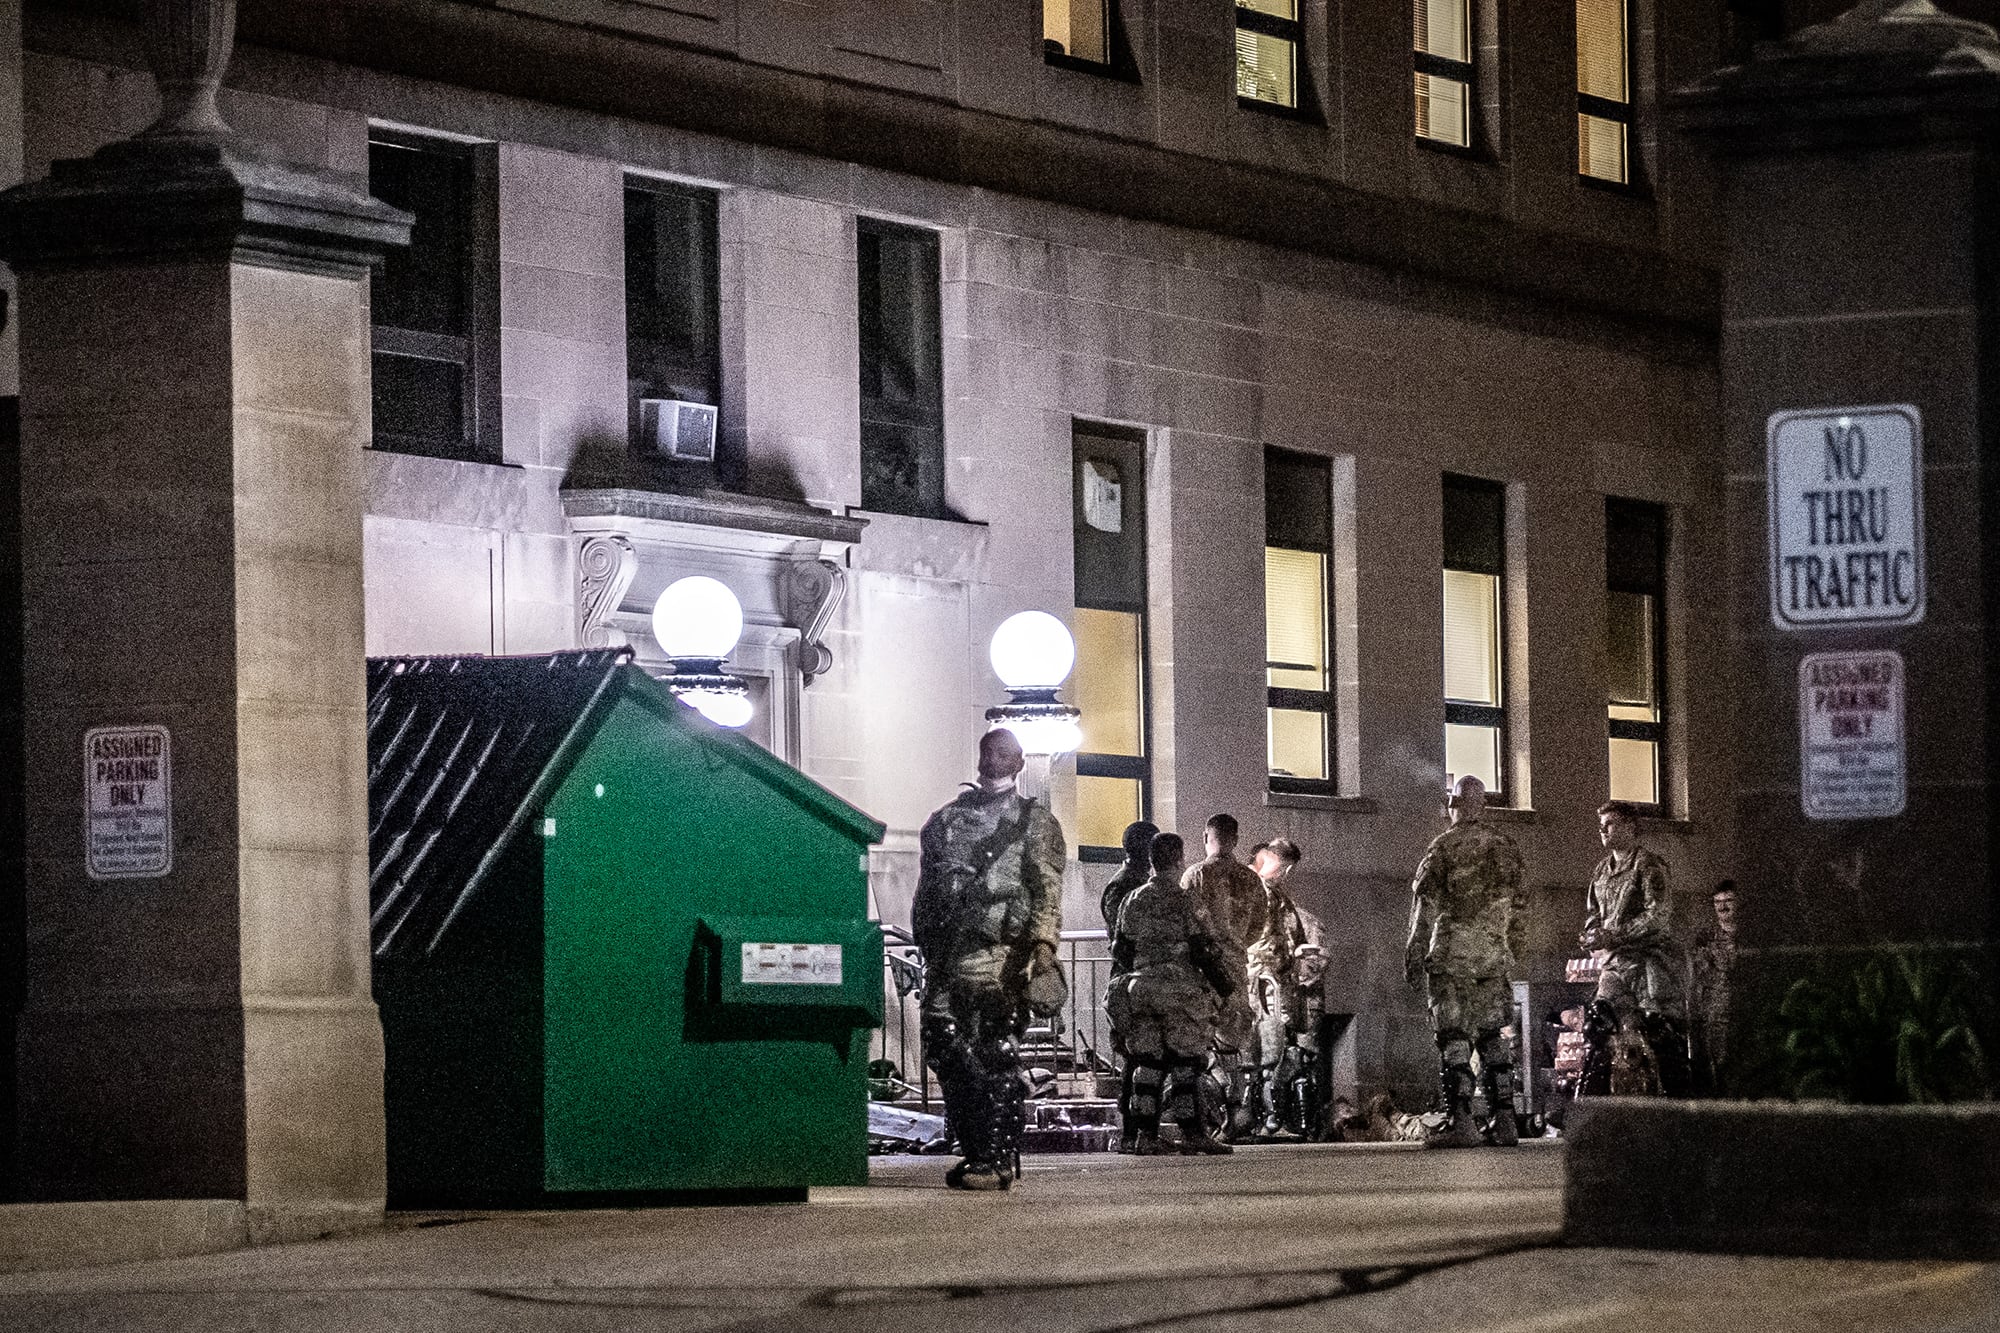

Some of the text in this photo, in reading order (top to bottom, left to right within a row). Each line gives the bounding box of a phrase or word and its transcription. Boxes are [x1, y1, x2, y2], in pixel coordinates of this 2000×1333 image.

[1824, 425, 1866, 481] NO
[1803, 487, 1887, 545] THRU
[1784, 551, 1910, 610] TRAFFIC
[1815, 685, 1890, 712] PARKING
[92, 735, 162, 758] ASSIGNED
[96, 758, 159, 782] PARKING
[110, 784, 145, 806] ONLY
